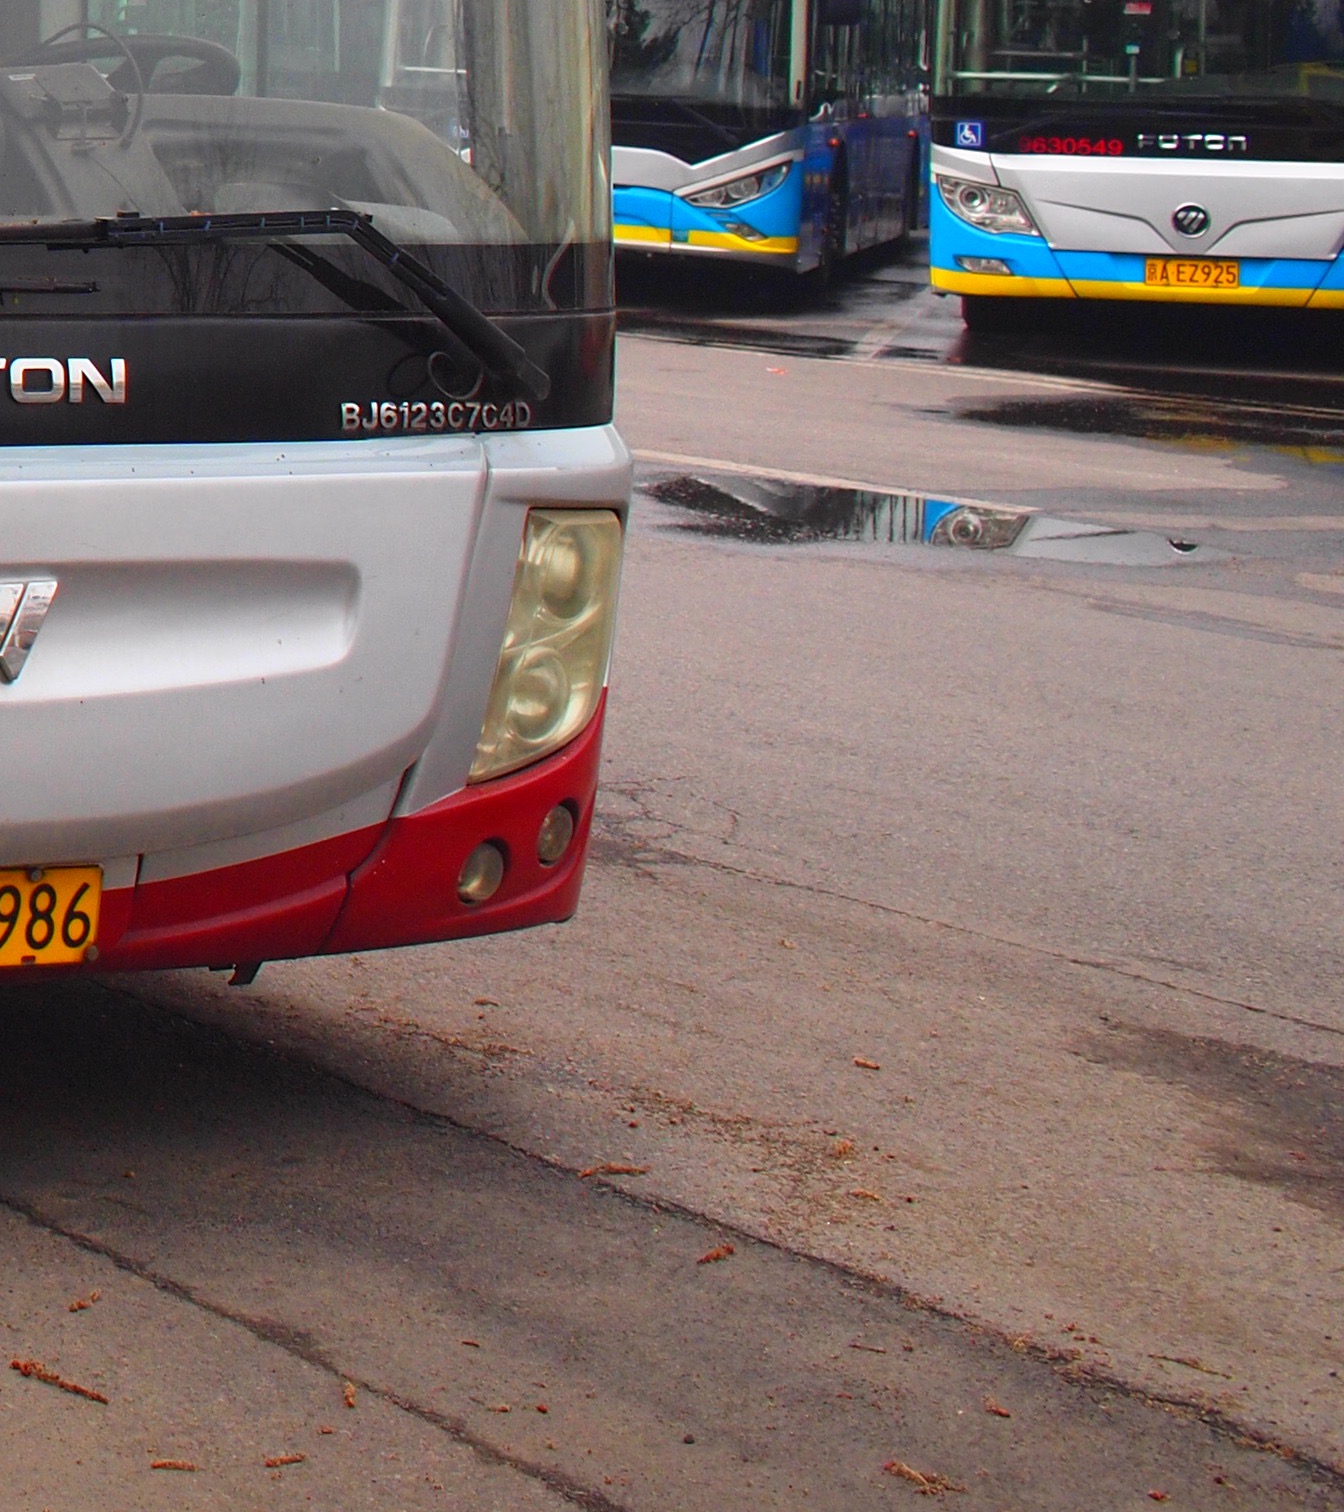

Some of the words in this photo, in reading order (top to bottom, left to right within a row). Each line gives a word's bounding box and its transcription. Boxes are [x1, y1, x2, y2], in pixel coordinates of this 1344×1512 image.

[1019, 136, 1123, 156] 9630549
[1137, 133, 1247, 152] FOTON
[340, 400, 532, 431] BJ6123C7C4D
